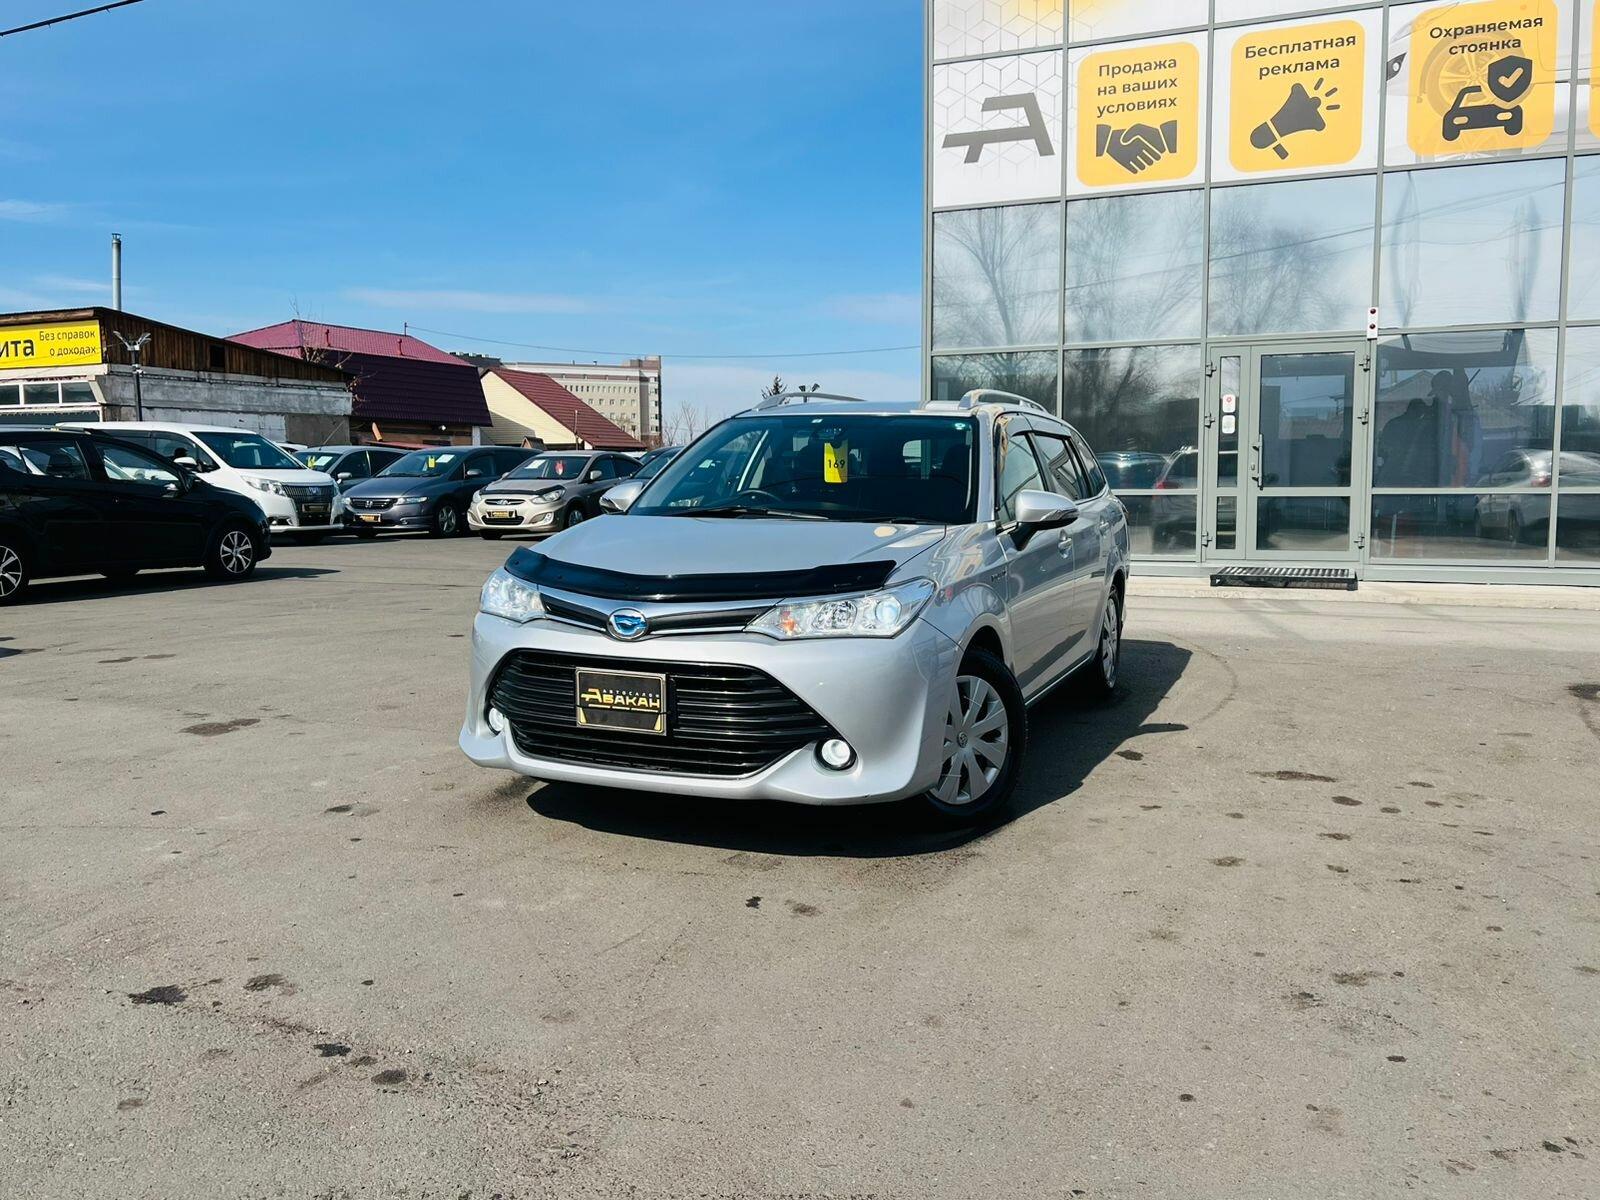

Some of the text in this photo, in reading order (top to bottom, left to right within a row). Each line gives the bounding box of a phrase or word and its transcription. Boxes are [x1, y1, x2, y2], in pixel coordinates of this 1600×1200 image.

[1430, 17, 1543, 39] Охраняемая
[1245, 35, 1356, 59] Бесплатная
[1448, 38, 1521, 56] стоянка
[1099, 58, 1177, 78] Продажа
[1259, 57, 1340, 80] реклама
[1097, 77, 1178, 96] на ваших
[1097, 97, 1177, 118] условиях
[40, 330, 96, 341] Без справок
[49, 346, 96, 356] о доходах
[828, 459, 845, 469] 169
[580, 688, 660, 708] АБАКАН
